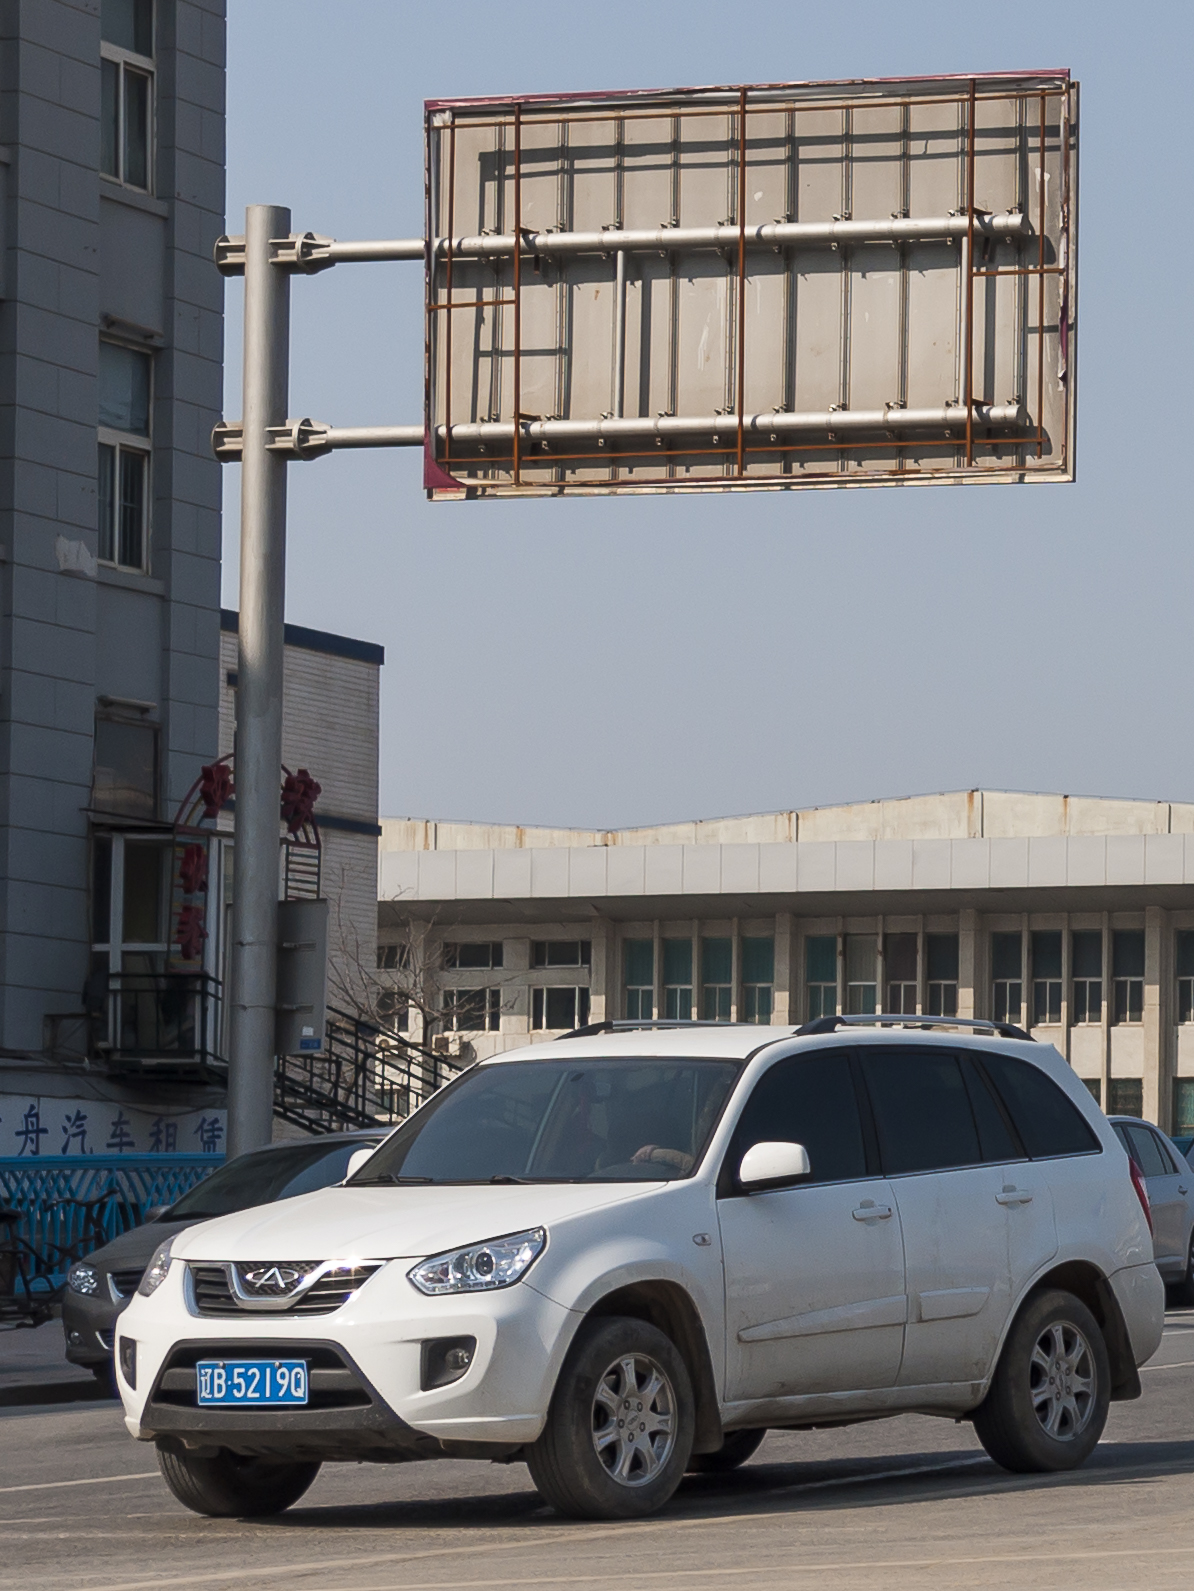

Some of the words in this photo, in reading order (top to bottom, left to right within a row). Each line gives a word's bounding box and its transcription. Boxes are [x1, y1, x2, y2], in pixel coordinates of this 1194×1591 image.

[0, 1103, 224, 1157] 舟汽车租赁
